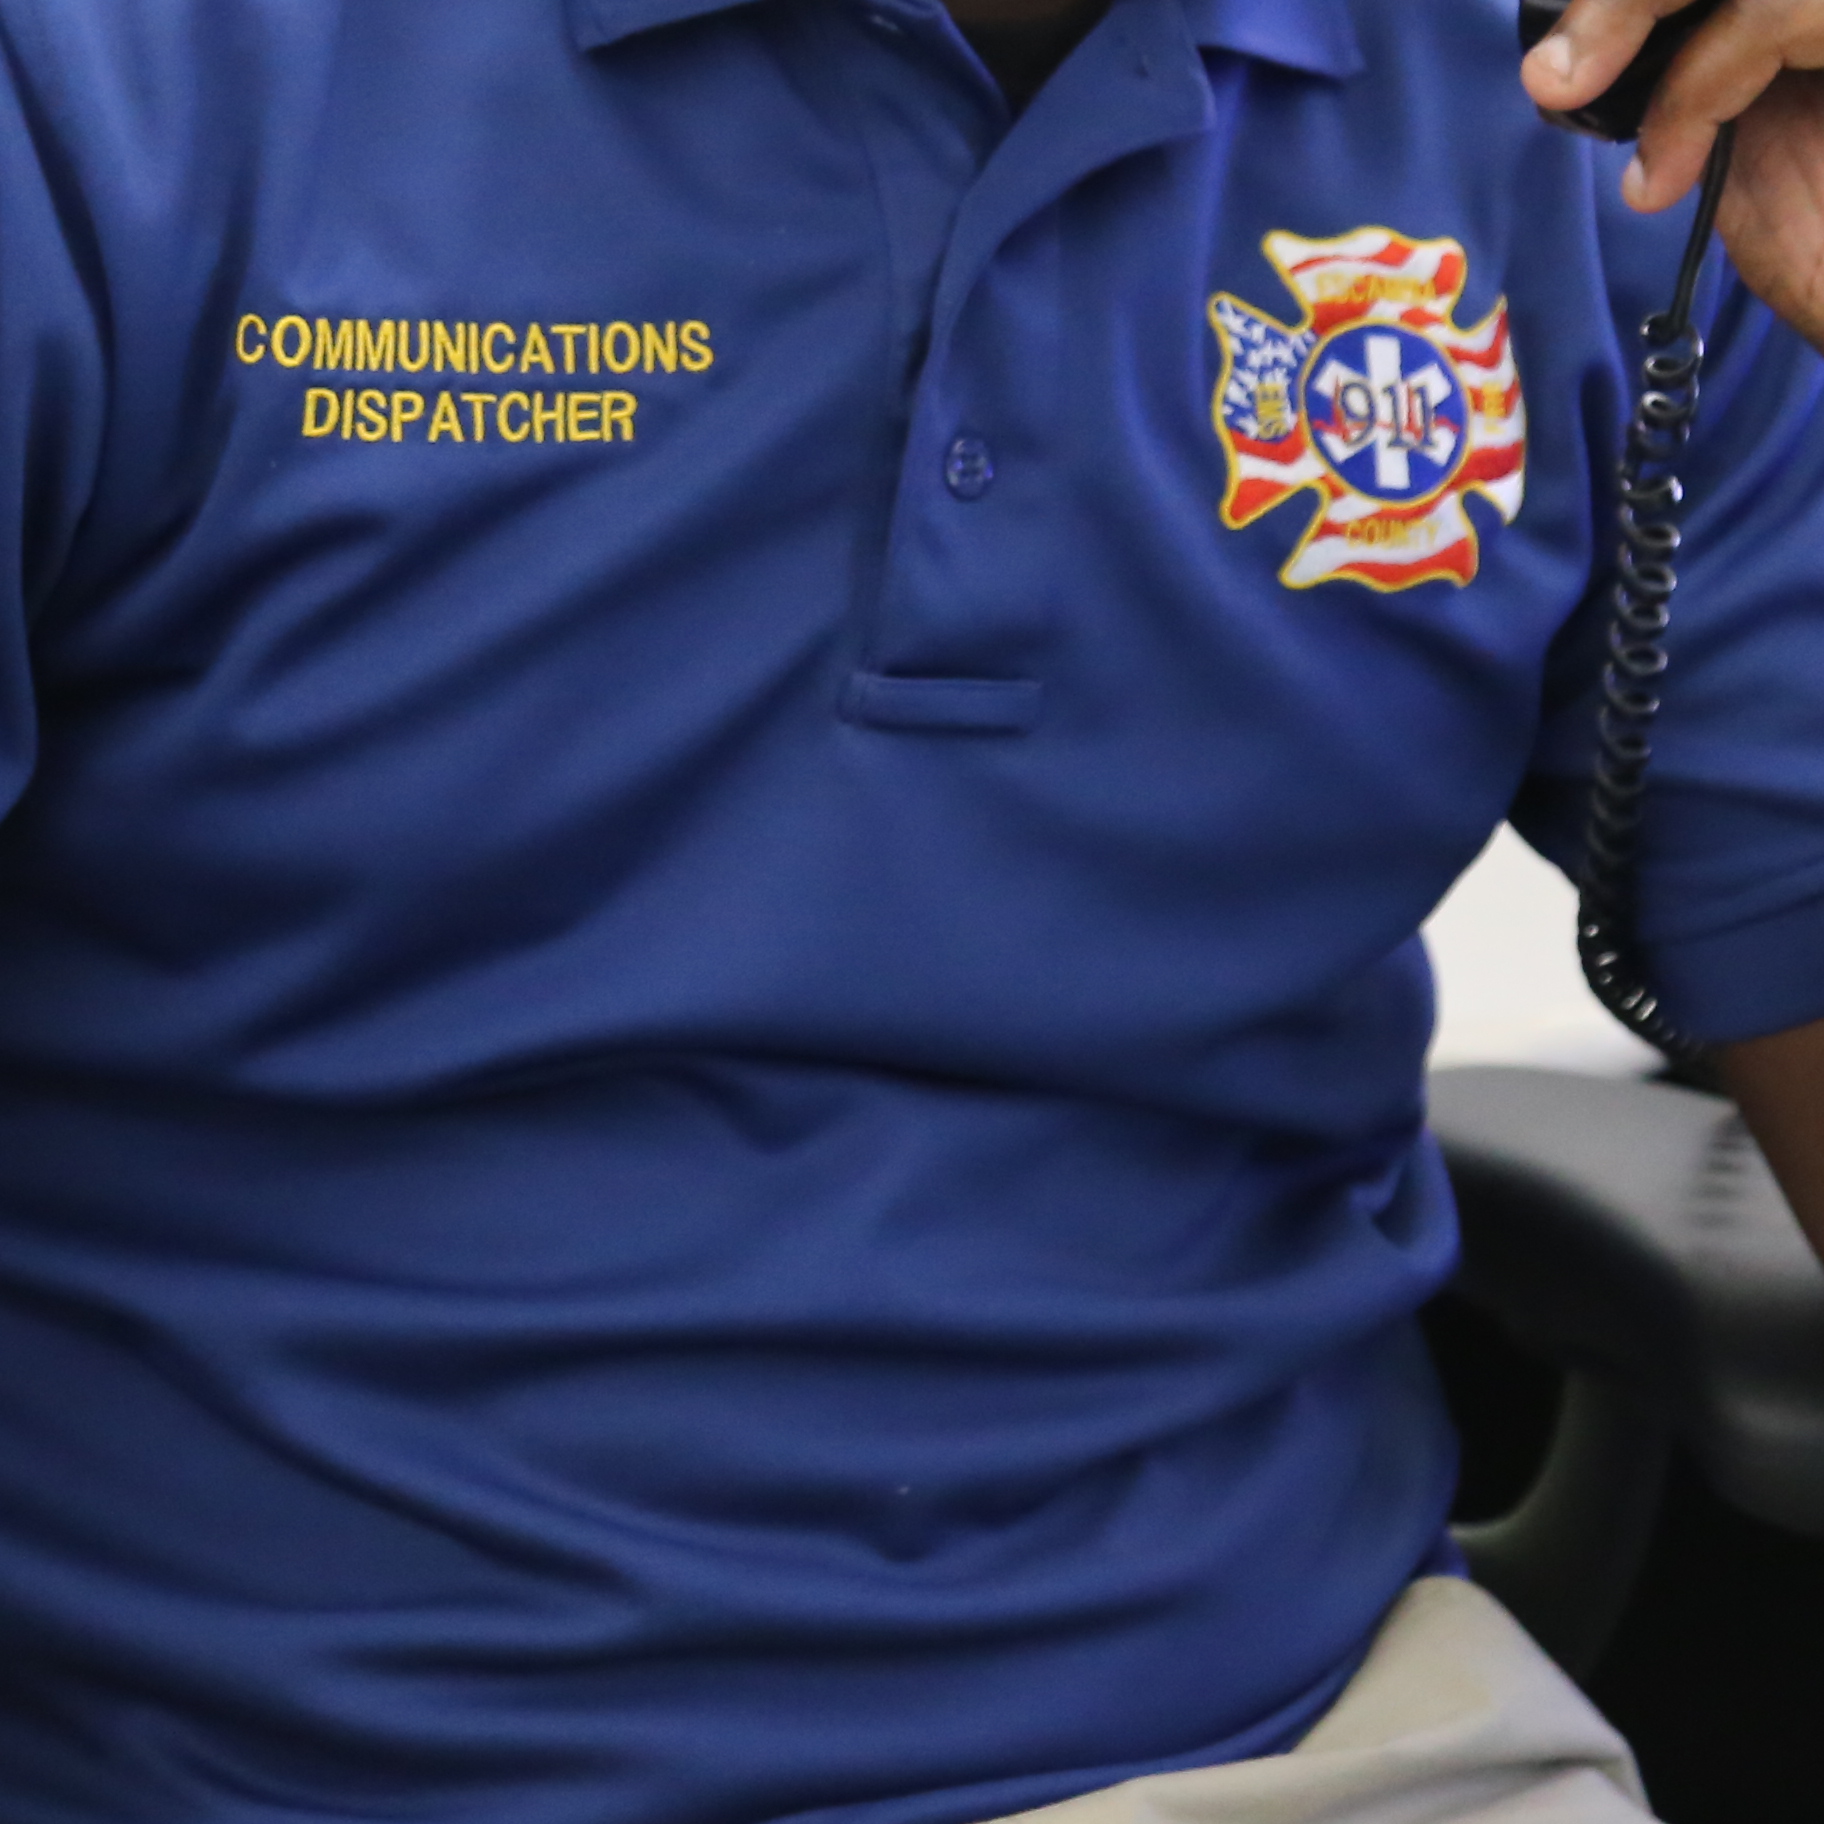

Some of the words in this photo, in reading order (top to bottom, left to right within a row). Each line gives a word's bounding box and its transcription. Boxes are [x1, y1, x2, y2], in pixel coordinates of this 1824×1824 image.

[235, 312, 715, 374] COMMUNICATIONS
[301, 387, 639, 443] DISPATCHER
[1341, 381, 1438, 449] 911
